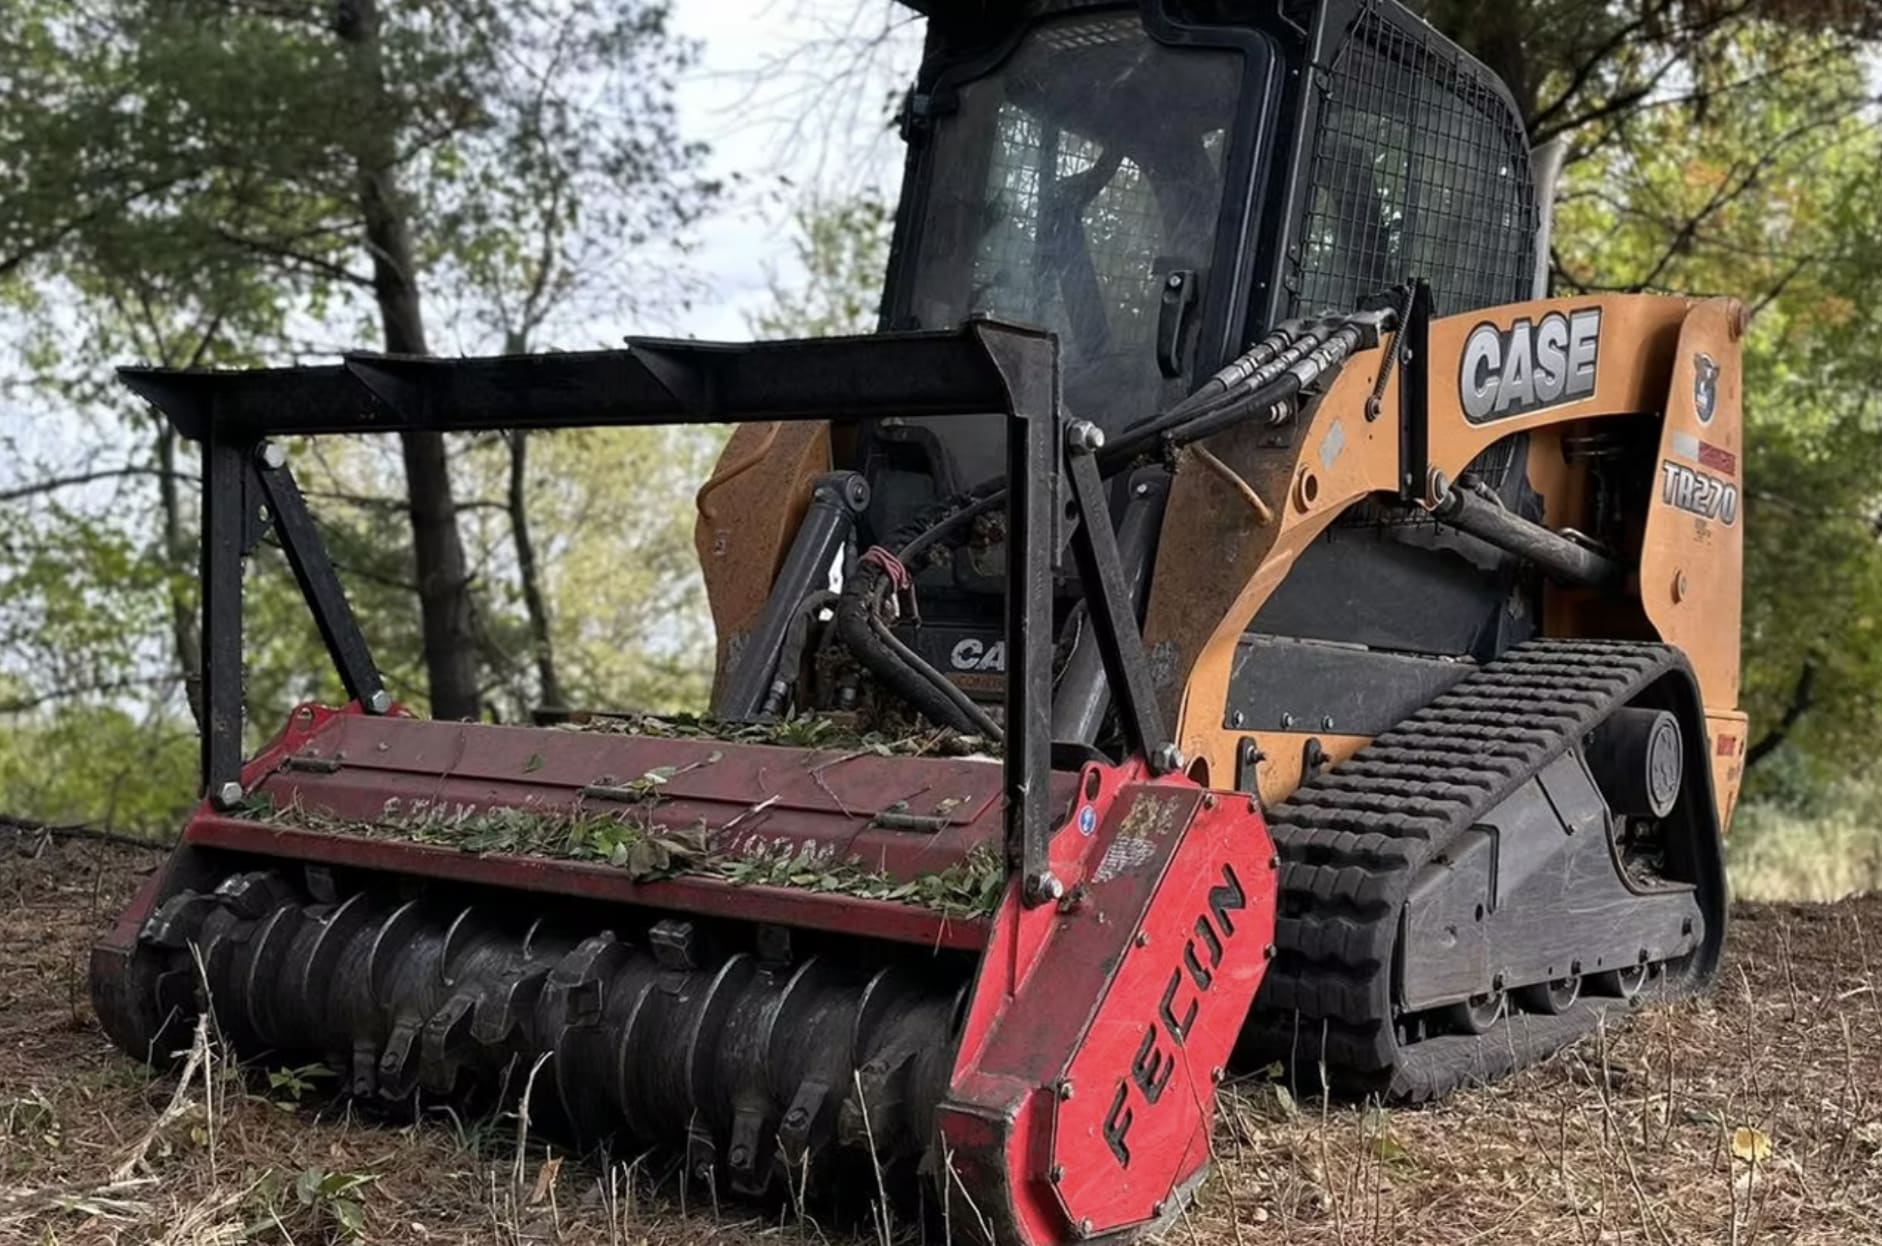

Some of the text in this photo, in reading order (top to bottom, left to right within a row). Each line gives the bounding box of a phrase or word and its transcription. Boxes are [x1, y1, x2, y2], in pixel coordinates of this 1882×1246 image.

[1460, 308, 1601, 420] CASE
[1663, 461, 1737, 526] TR270
[951, 638, 1005, 672] CA
[1102, 862, 1246, 1169] FECON
